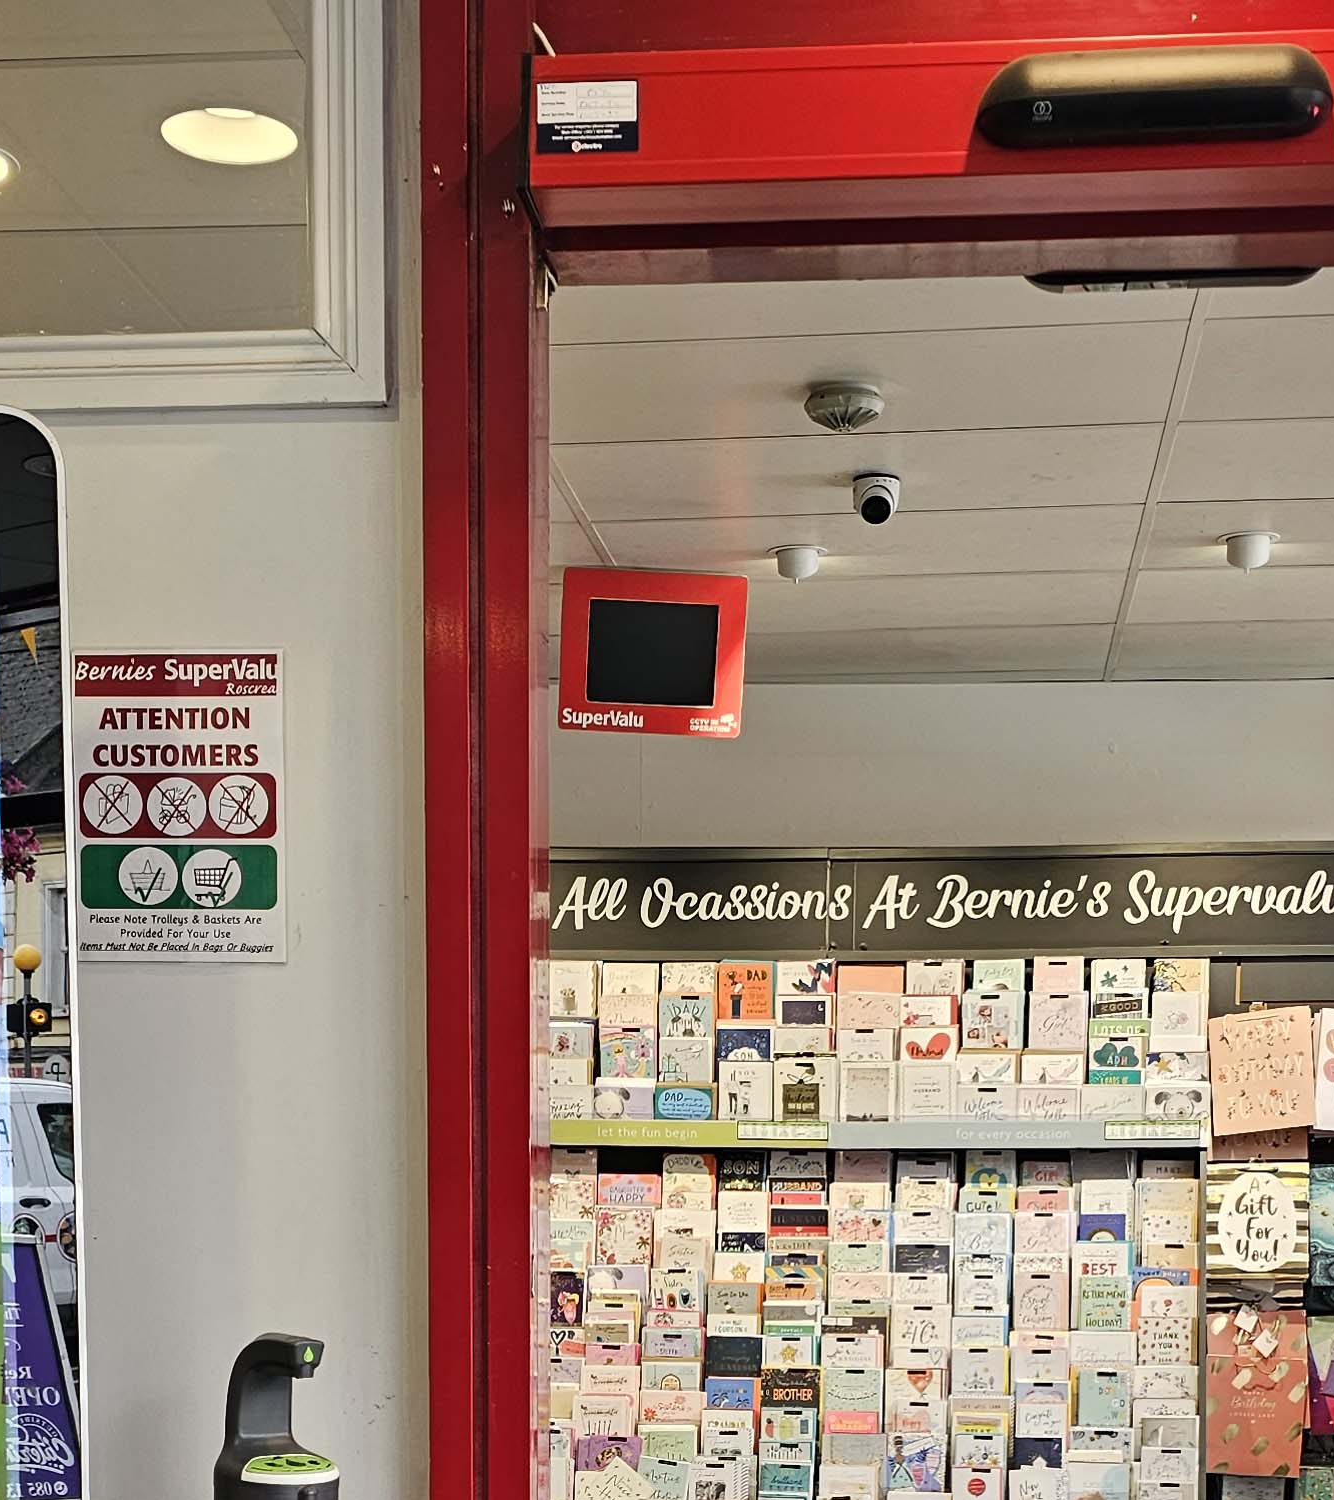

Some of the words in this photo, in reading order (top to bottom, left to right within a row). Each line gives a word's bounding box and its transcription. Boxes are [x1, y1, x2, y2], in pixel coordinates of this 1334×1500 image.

[75, 658, 156, 682] Bernies
[225, 683, 277, 695] Roscrea
[99, 707, 251, 730] ATTENTION
[562, 707, 644, 729] SuperValu
[92, 744, 259, 767] CUSTOMERS
[552, 876, 628, 931] All
[640, 877, 852, 930] Ocassions
[863, 874, 920, 931] At
[926, 874, 1108, 930] Bernie's
[90, 914, 121, 926] Please
[123, 914, 148, 926] Note
[151, 914, 189, 927] Trolleys
[193, 914, 200, 926] &
[204, 914, 241, 926] Baskets
[244, 915, 262, 926] Are
[120, 928, 164, 940] Provided
[167, 928, 185, 939] For
[187, 928, 210, 940] Your
[213, 929, 231, 940] Use
[80, 942, 103, 952] Items
[105, 942, 126, 952] Must
[128, 942, 145, 952] Not
[147, 942, 160, 952] Be
[162, 942, 190, 952] Placed
[192, 943, 200, 952] In
[202, 943, 224, 954] Bags
[227, 943, 237, 952] Or
[239, 943, 274, 955] Buggies
[746, 969, 768, 981] DAD
[597, 1126, 617, 1138] let
[620, 1126, 637, 1138] the
[641, 1126, 662, 1138] fun
[664, 1127, 698, 1141] begin
[956, 1128, 974, 1140] for
[978, 1130, 1012, 1143] every
[1017, 1129, 1071, 1140] occasion
[723, 1160, 760, 1176] SON
[772, 1181, 823, 1192] HUSBAND
[1250, 1178, 1260, 1192] A
[1234, 1192, 1278, 1216] Gift
[1246, 1217, 1275, 1240] For
[1235, 1239, 1278, 1262] You!
[1082, 1262, 1117, 1276] BEST
[772, 1388, 813, 1402] BROTHER
